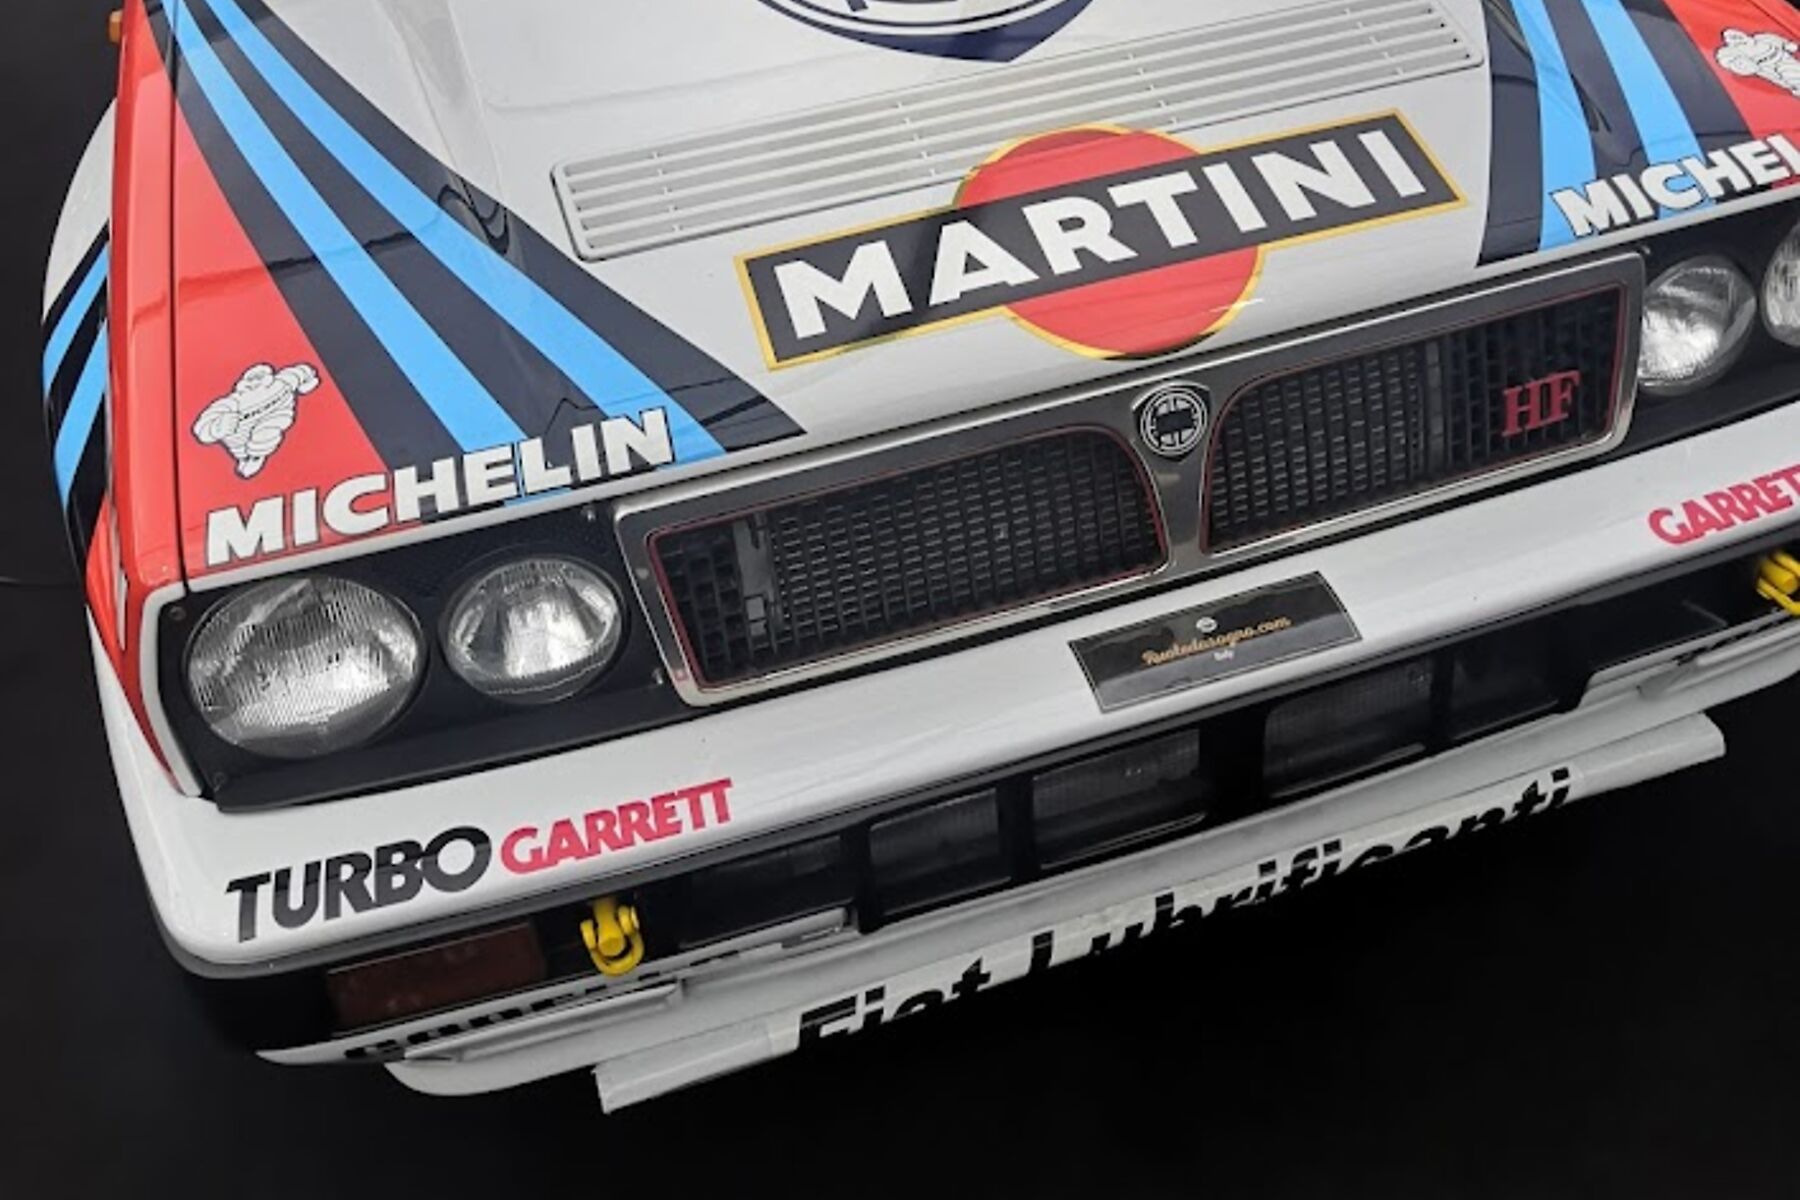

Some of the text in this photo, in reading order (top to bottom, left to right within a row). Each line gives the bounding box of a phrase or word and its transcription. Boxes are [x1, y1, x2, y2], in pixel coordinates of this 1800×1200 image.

[772, 129, 1428, 340] MARTINI
[1502, 370, 1580, 437] HF
[205, 407, 677, 567] MICHELIN
[226, 777, 734, 942] TURBO GARRETT
